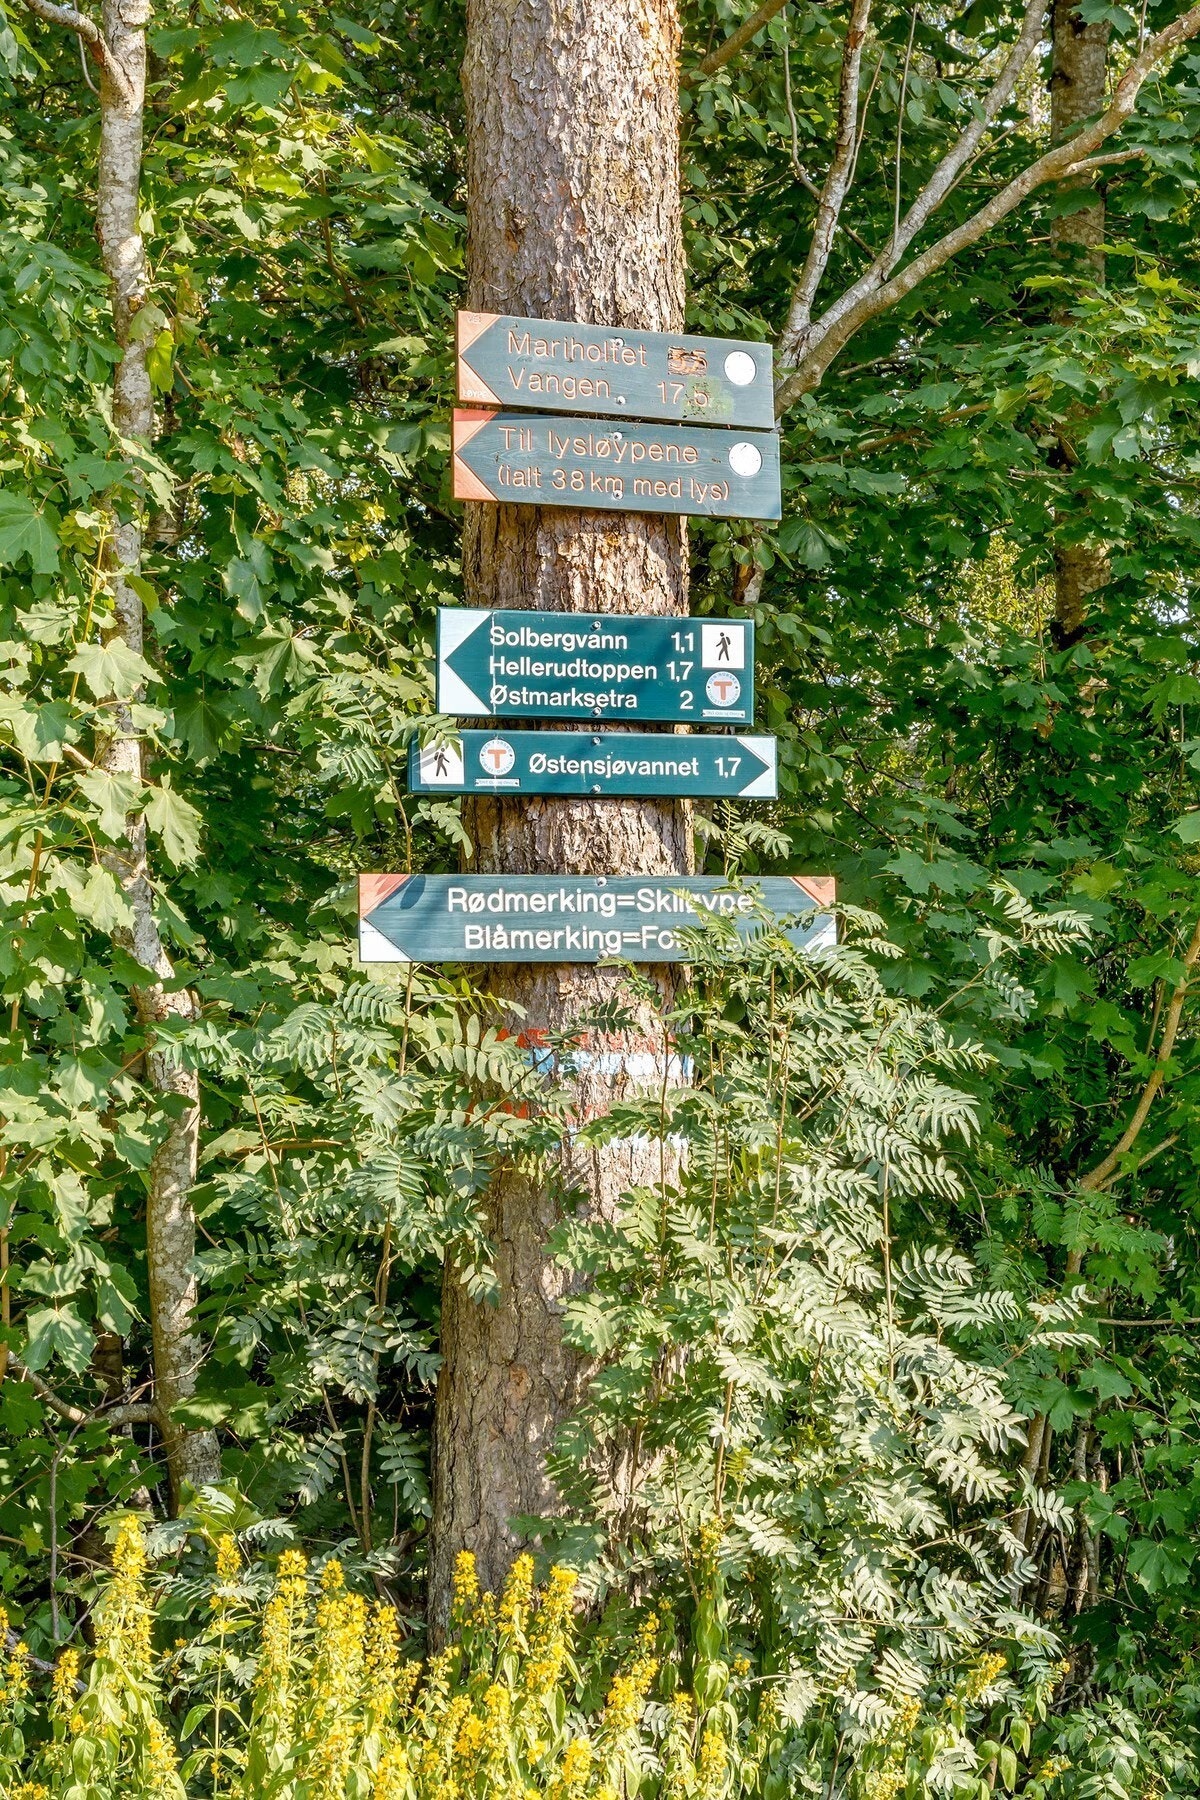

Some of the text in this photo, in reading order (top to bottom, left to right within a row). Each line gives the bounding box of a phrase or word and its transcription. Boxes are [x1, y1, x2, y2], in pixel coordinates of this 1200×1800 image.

[508, 331, 648, 366] Mariholtet
[507, 366, 611, 399] Vangen
[498, 426, 698, 464] Til lysløypene
[498, 464, 542, 489] (ialt
[633, 477, 682, 498] med
[690, 479, 730, 504] lys)
[489, 626, 695, 655] Solbergvann 1,1
[489, 656, 694, 683] Hellerudtoppen 1,7
[489, 684, 694, 710] Østmarksetra 2
[529, 754, 742, 780] Østensjøvannet 1,7
